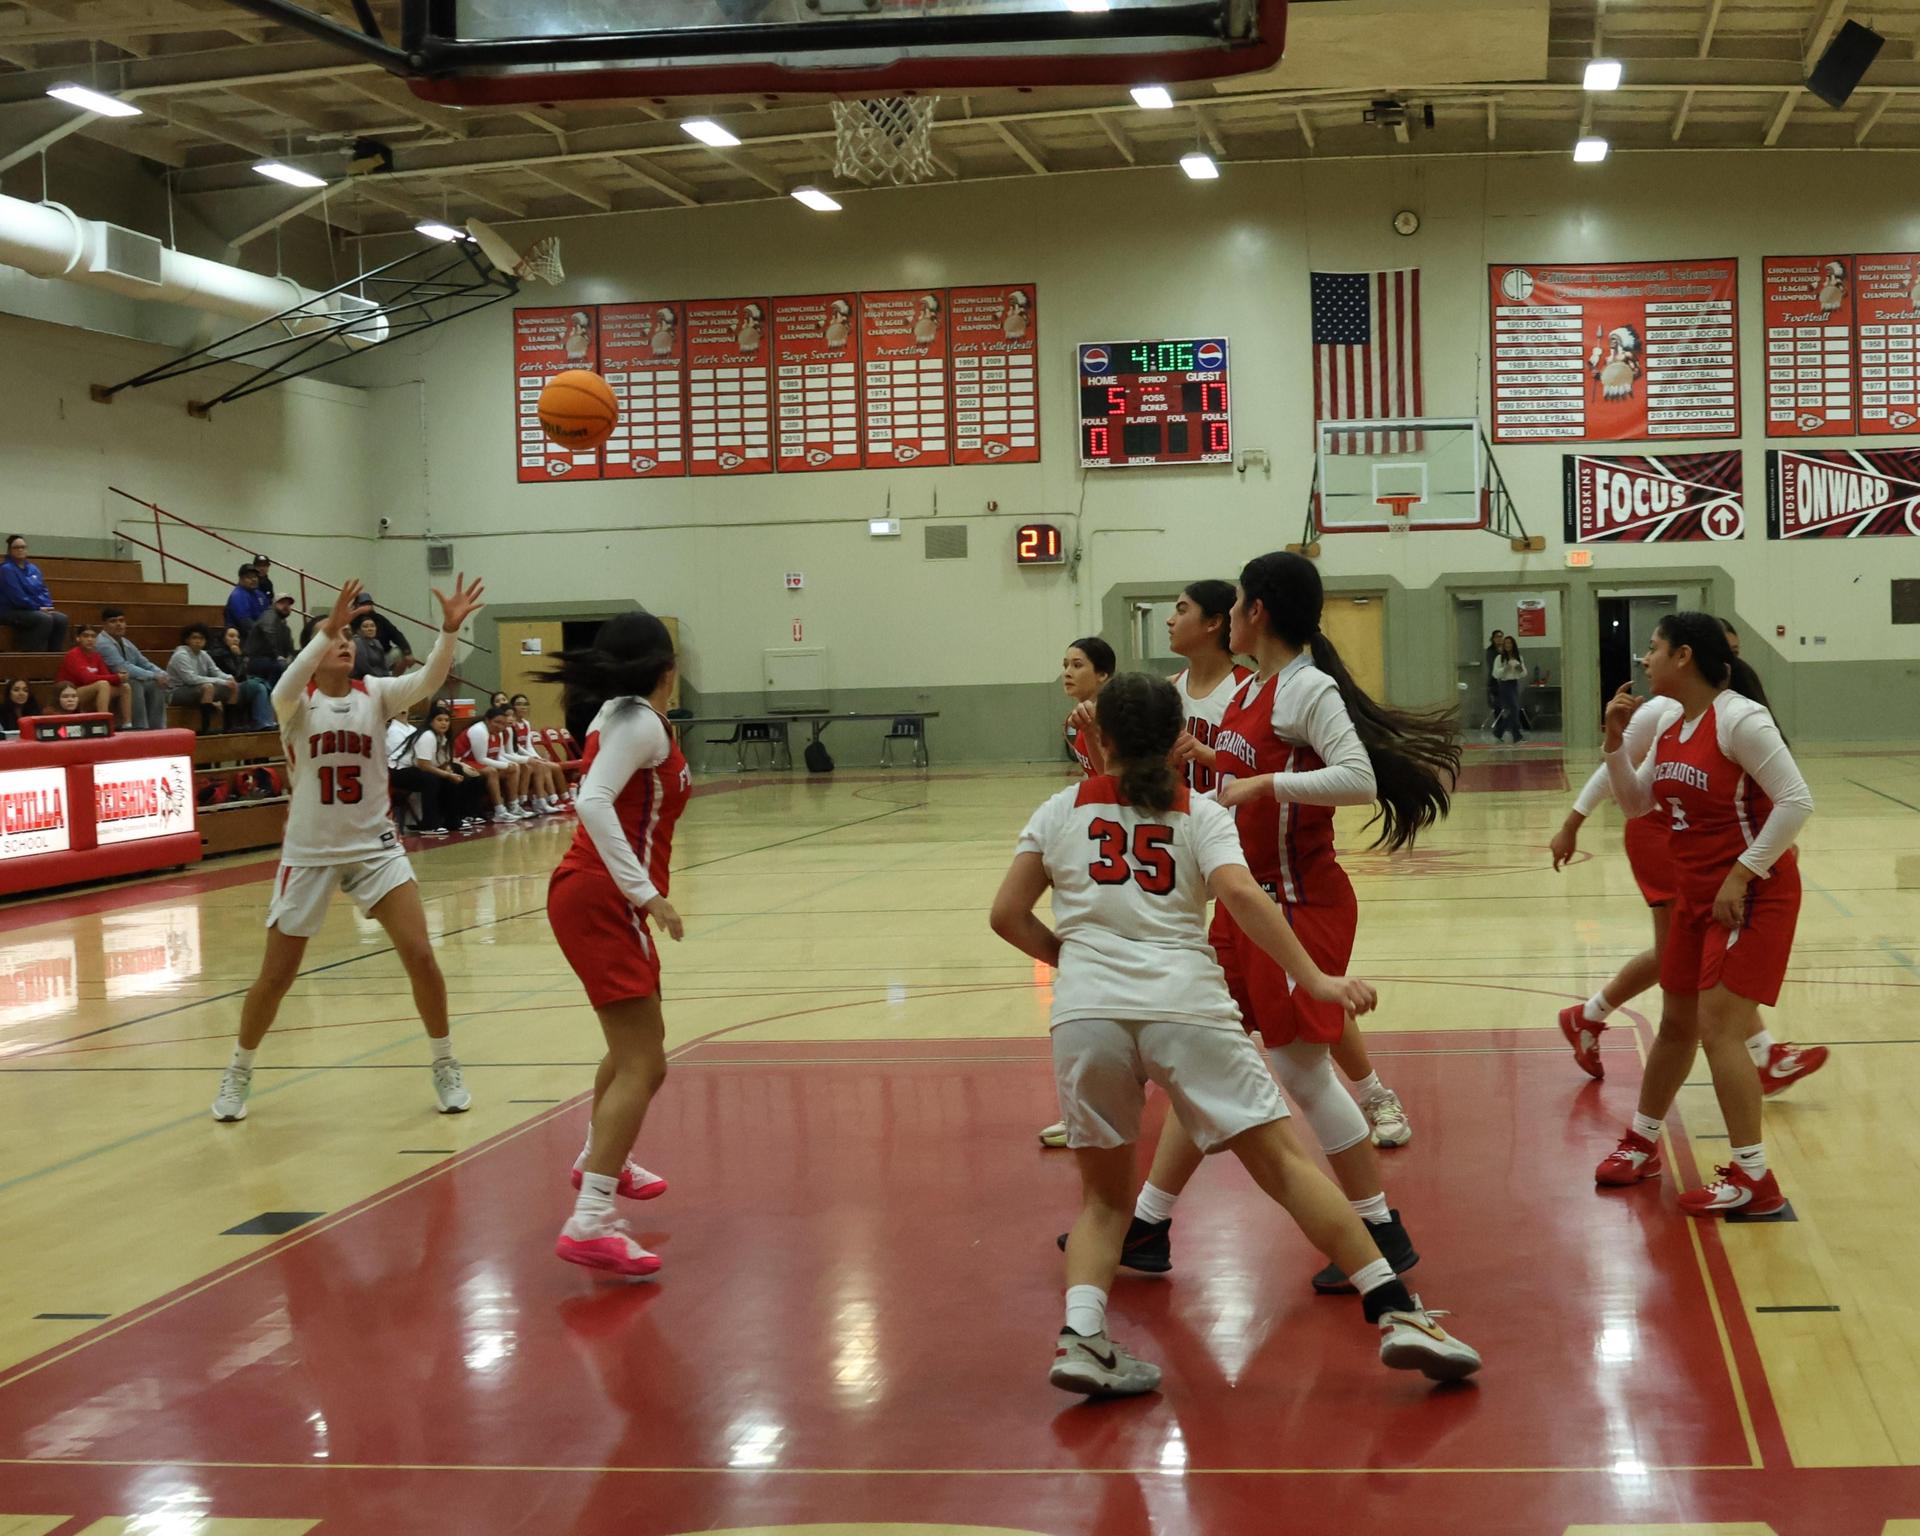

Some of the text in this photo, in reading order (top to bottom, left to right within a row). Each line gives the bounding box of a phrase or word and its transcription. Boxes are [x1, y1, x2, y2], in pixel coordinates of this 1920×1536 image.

[1782, 312, 1831, 322] Football
[782, 352, 807, 362] Boys
[981, 341, 1033, 352] Volleyball
[1131, 343, 1194, 372] 4:06
[1088, 372, 1221, 386] HOME PERIOD GUEST
[1108, 383, 1227, 415] 5 17
[1167, 414, 1188, 422] FOUL
[1201, 413, 1228, 421] FOULS
[1091, 423, 1228, 455] 0 0
[1581, 467, 1593, 529] REDSKINS
[1595, 467, 1687, 528] FOCUS
[1784, 463, 1795, 525] REDSKINS
[1797, 463, 1889, 525] ONWARD
[1021, 530, 1055, 557] 21
[309, 730, 372, 759] TRIBE
[318, 765, 363, 805] 15
[0, 788, 64, 833] CHILLA
[4, 836, 48, 853] SCHOOL
[1089, 817, 1176, 896] 35
